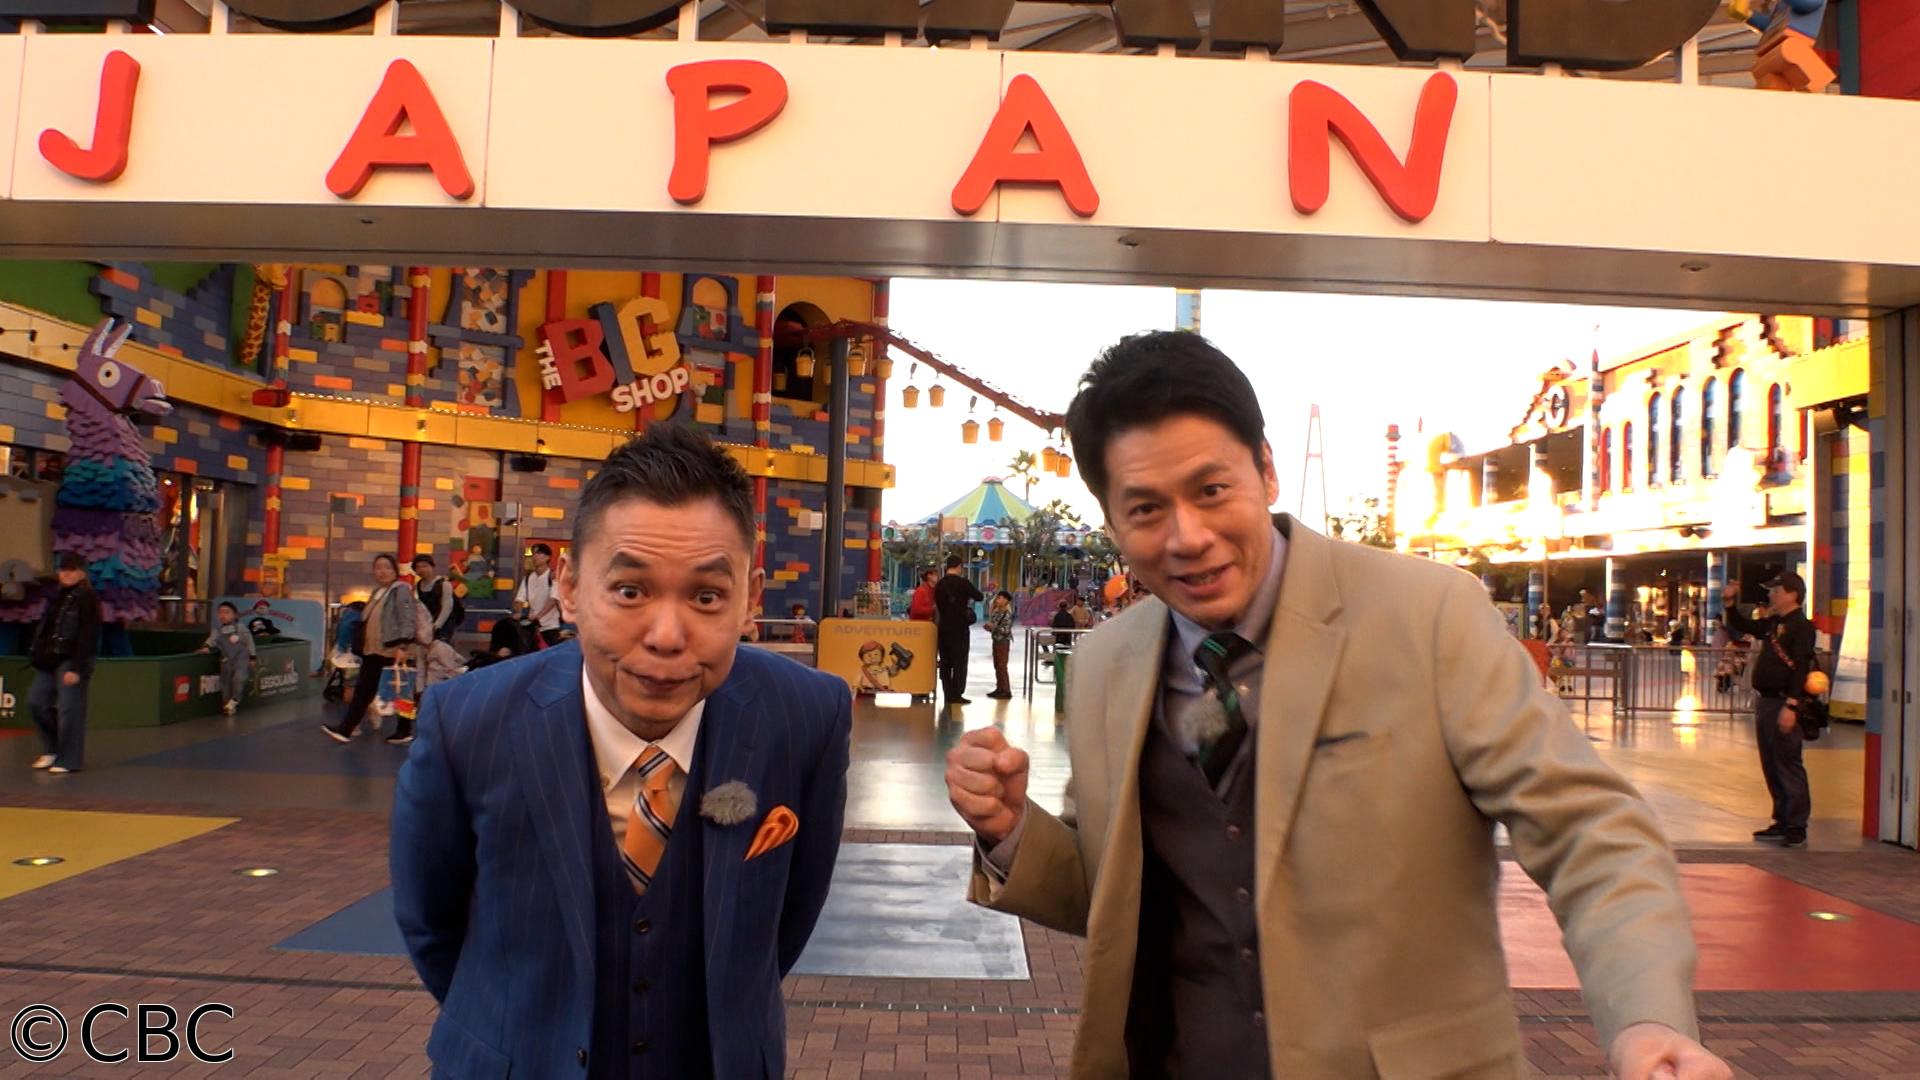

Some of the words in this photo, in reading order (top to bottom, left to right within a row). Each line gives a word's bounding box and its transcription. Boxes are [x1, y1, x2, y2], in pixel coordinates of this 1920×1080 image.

[38, 49, 1458, 223] JAPAN
[535, 339, 562, 390] THE
[542, 297, 681, 403] BIG
[611, 367, 688, 412] SHOP
[832, 625, 922, 636] ADVENTURE
